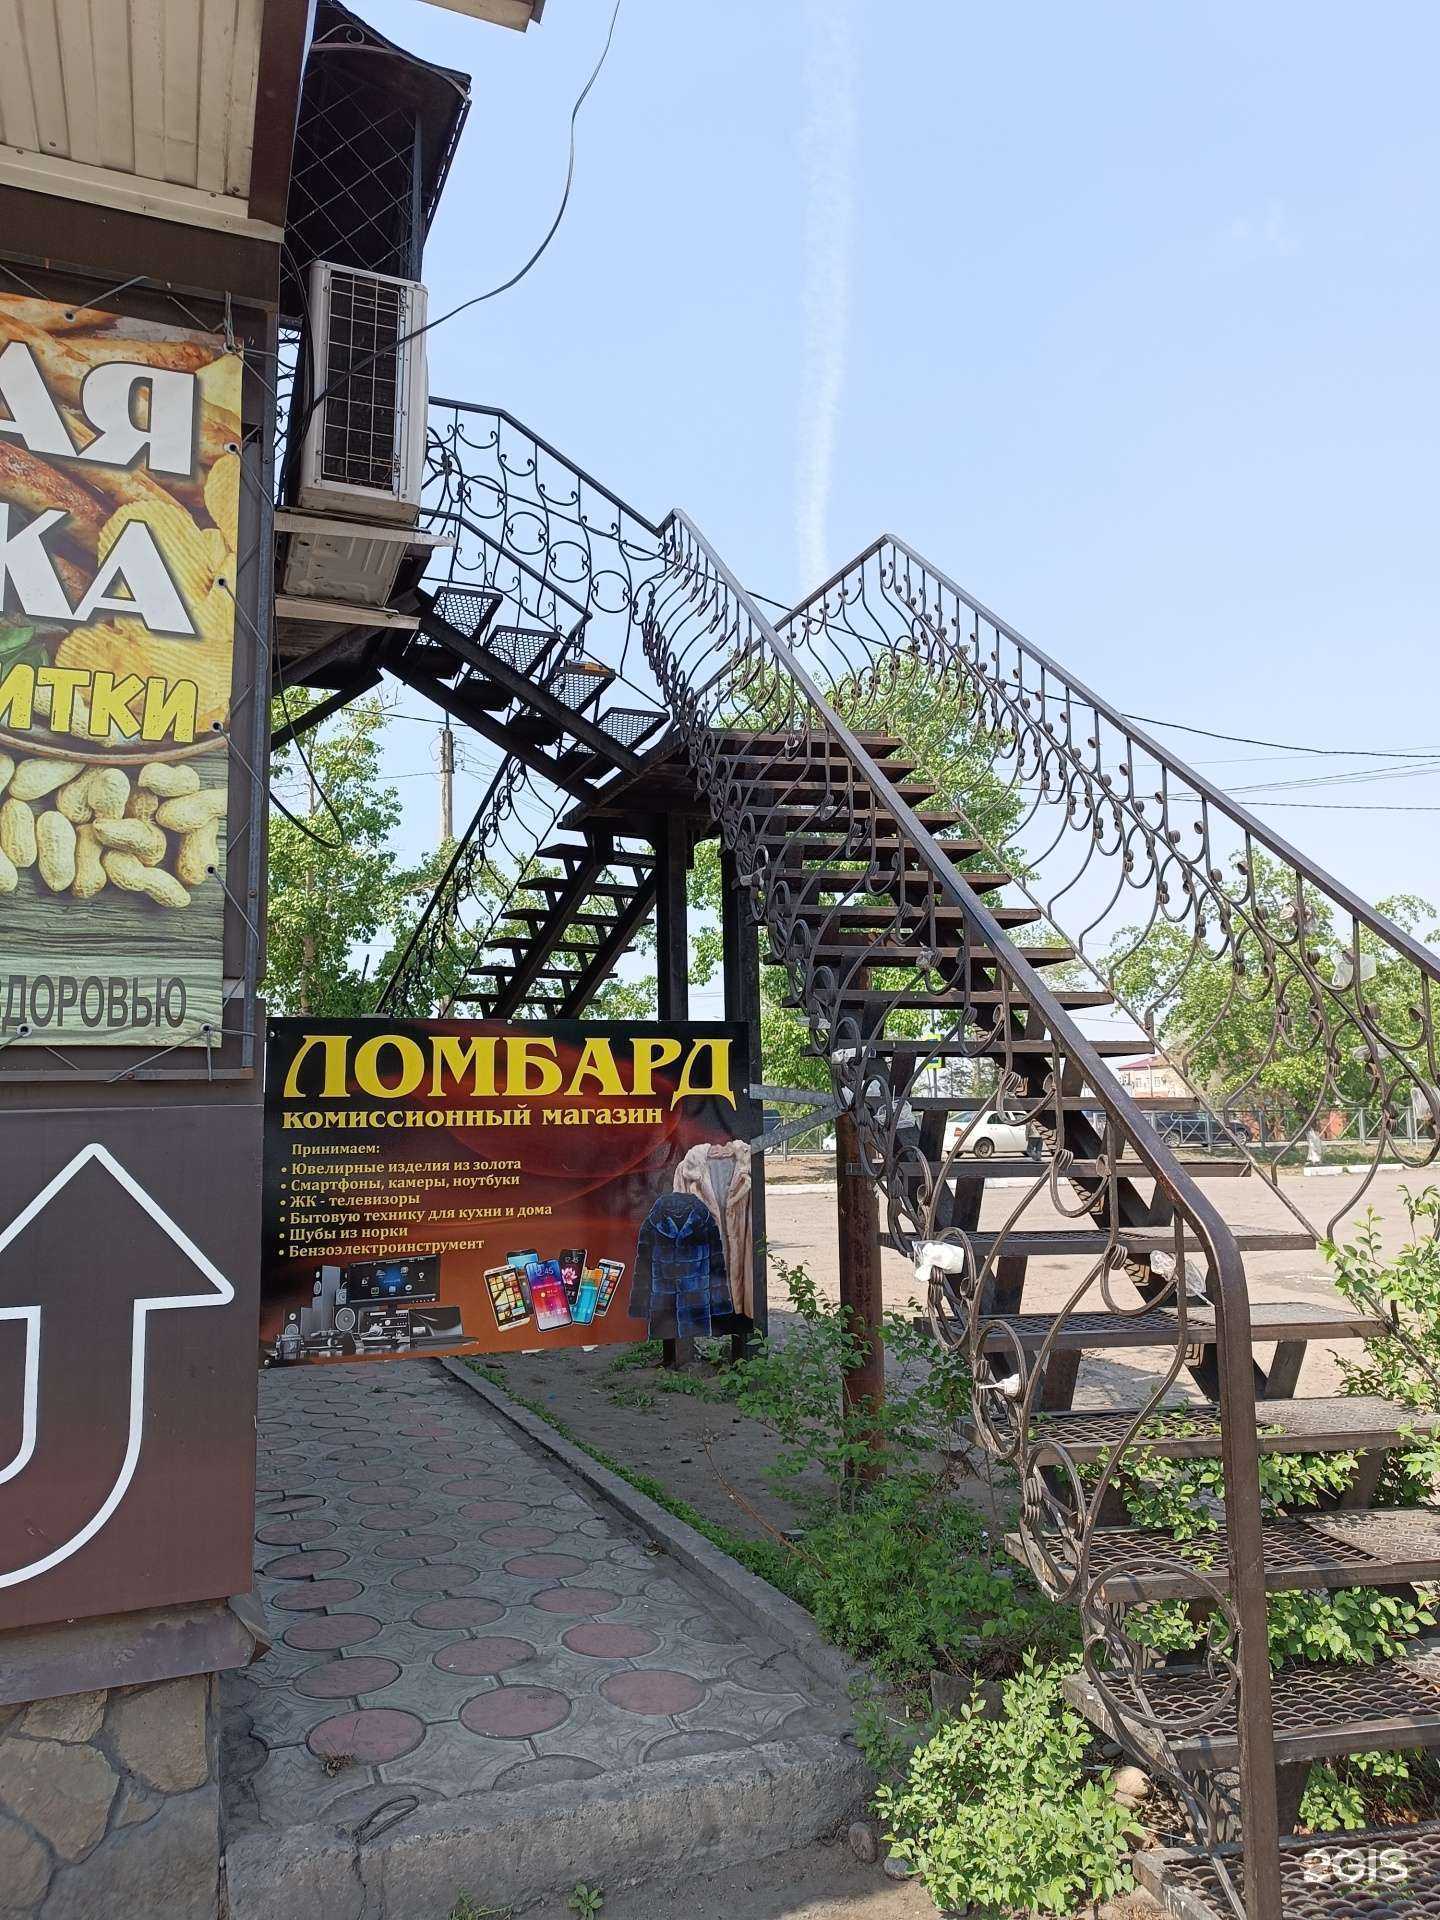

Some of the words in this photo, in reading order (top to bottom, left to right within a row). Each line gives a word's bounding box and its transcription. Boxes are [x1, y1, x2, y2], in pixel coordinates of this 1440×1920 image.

[0, 341, 196, 476] АЯ
[0, 505, 196, 635] КА
[283, 1034, 737, 1112] ЛОМБАРД
[282, 1103, 532, 1129] комиссионный
[541, 1107, 663, 1126] магазин
[292, 1143, 381, 1157] Принимаем:
[292, 1162, 385, 1176] Ювелирные
[388, 1162, 450, 1174] изделия
[453, 1161, 470, 1171] из
[473, 1160, 521, 1170] золота
[291, 1178, 385, 1193] Смартфоны,
[388, 1177, 450, 1190] камеры,
[453, 1174, 520, 1188] ноутбуки
[290, 1195, 317, 1208] ЖК
[329, 1194, 420, 1208] телевизоры
[290, 1211, 361, 1226] Бытовую
[364, 1209, 426, 1222] технику
[428, 1209, 455, 1221] для
[459, 1207, 502, 1220] кухни
[505, 1206, 514, 1216] и
[517, 1205, 553, 1218] дома
[290, 1227, 336, 1243] Шубы
[340, 1229, 358, 1239] из
[361, 1227, 408, 1240] норки
[289, 1239, 485, 1258] Бензоэлектроинструмент
